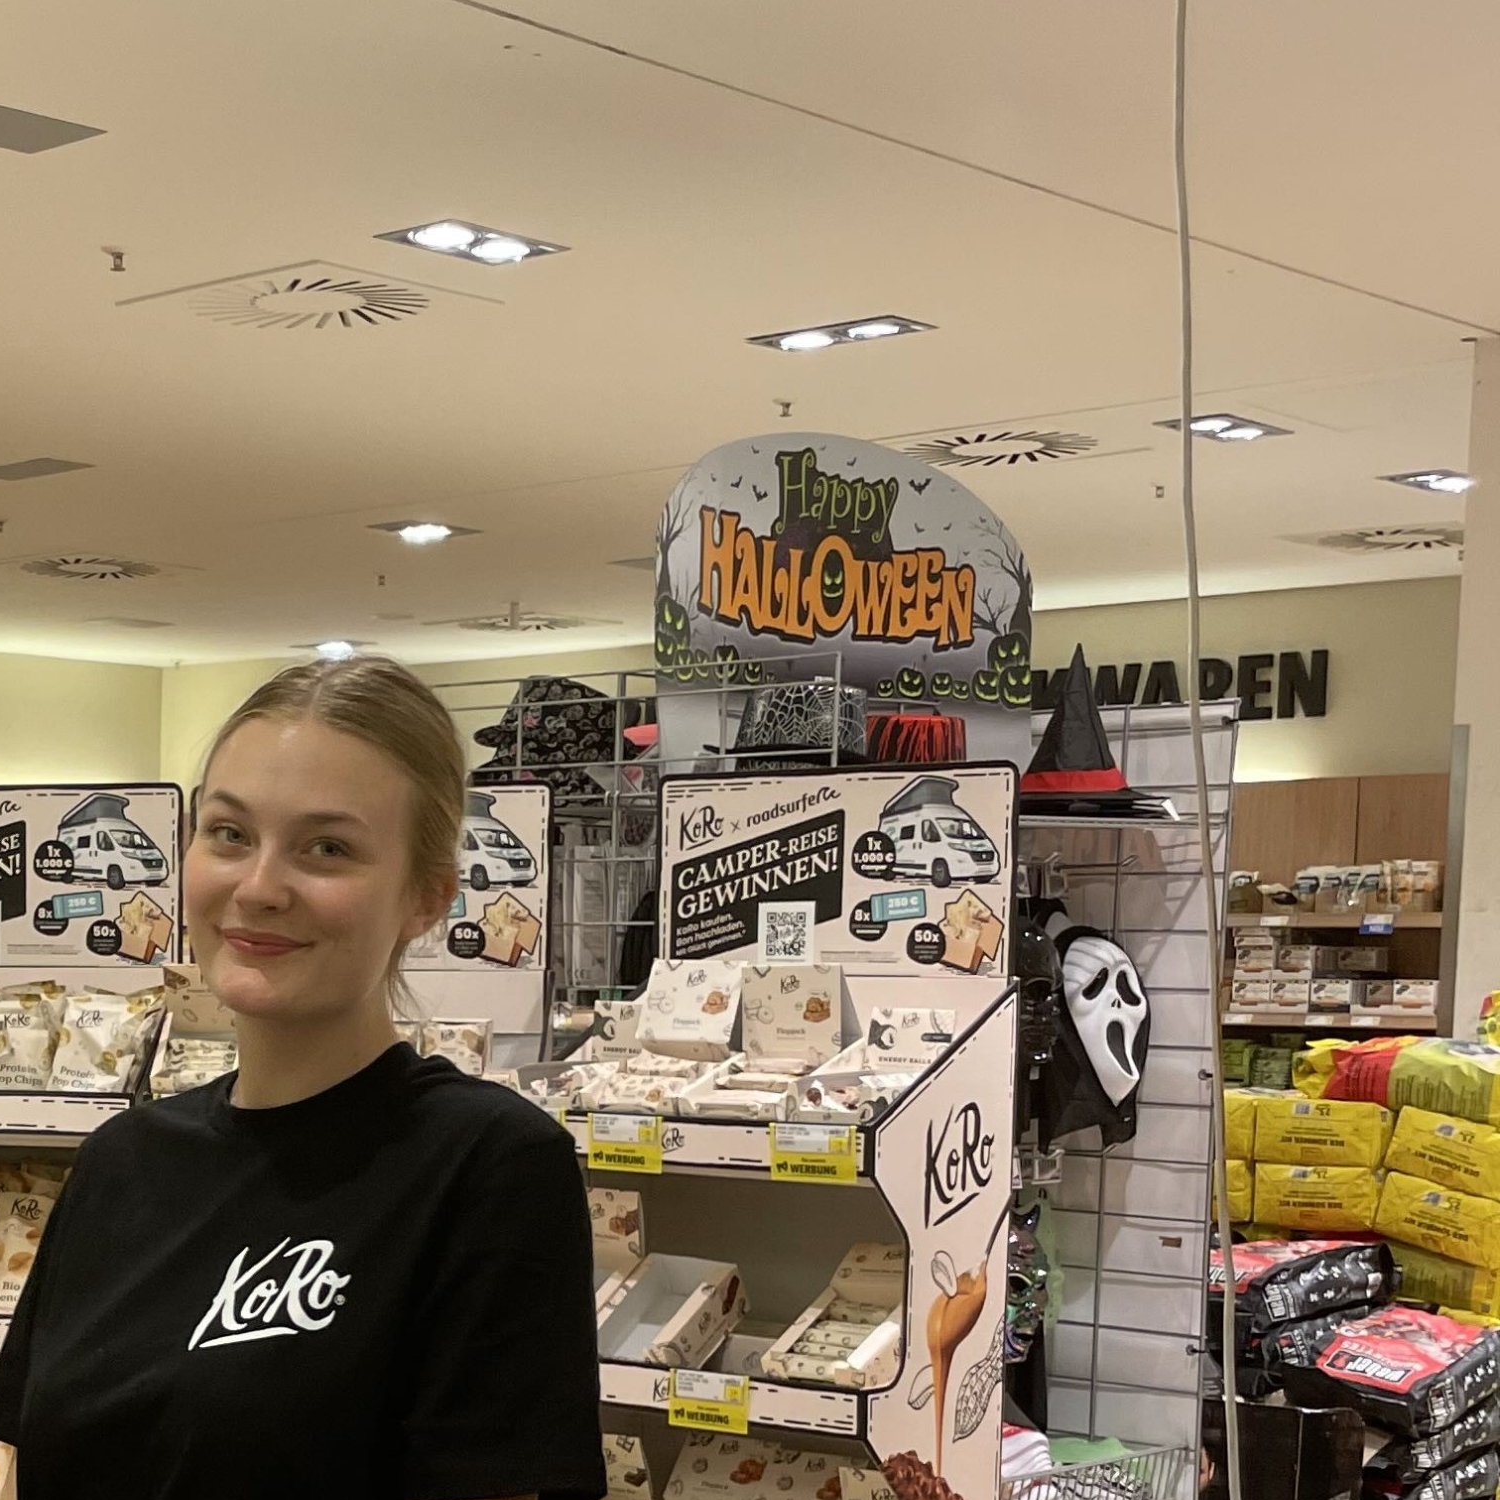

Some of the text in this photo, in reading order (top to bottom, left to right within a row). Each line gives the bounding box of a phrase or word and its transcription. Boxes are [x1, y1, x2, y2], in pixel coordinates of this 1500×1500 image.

[775, 449, 899, 543] Happy
[698, 507, 975, 652] HALLOWEEN
[680, 786, 841, 851] KoRo roadsurfer
[867, 837, 882, 851] 1x
[47, 845, 62, 858] 1x
[677, 823, 839, 892] CAMPER-REISE
[677, 848, 840, 920] GEWINNEN!
[37, 907, 53, 919] 8x
[854, 908, 870, 921] 8x
[92, 925, 117, 937] 50x
[454, 927, 480, 940] 50x
[914, 930, 940, 943] 50x
[686, 970, 707, 987] KoRo
[780, 974, 800, 993] KoRo
[3, 1012, 30, 1030] KoRo
[76, 1009, 104, 1029] KoRo
[0, 1063, 38, 1075] Protein
[60, 1065, 95, 1079] Protein
[13, 1075, 43, 1087] Chips
[52, 1076, 69, 1088] Pop
[604, 1154, 646, 1167] WERBUNG
[924, 1102, 994, 1229] KoRo
[789, 1163, 838, 1177] WERBUNG
[11, 1197, 42, 1221] KoRo
[2, 1281, 20, 1292] Bio
[188, 1236, 351, 1351] KoRo
[685, 1409, 730, 1426] WERBUNG
